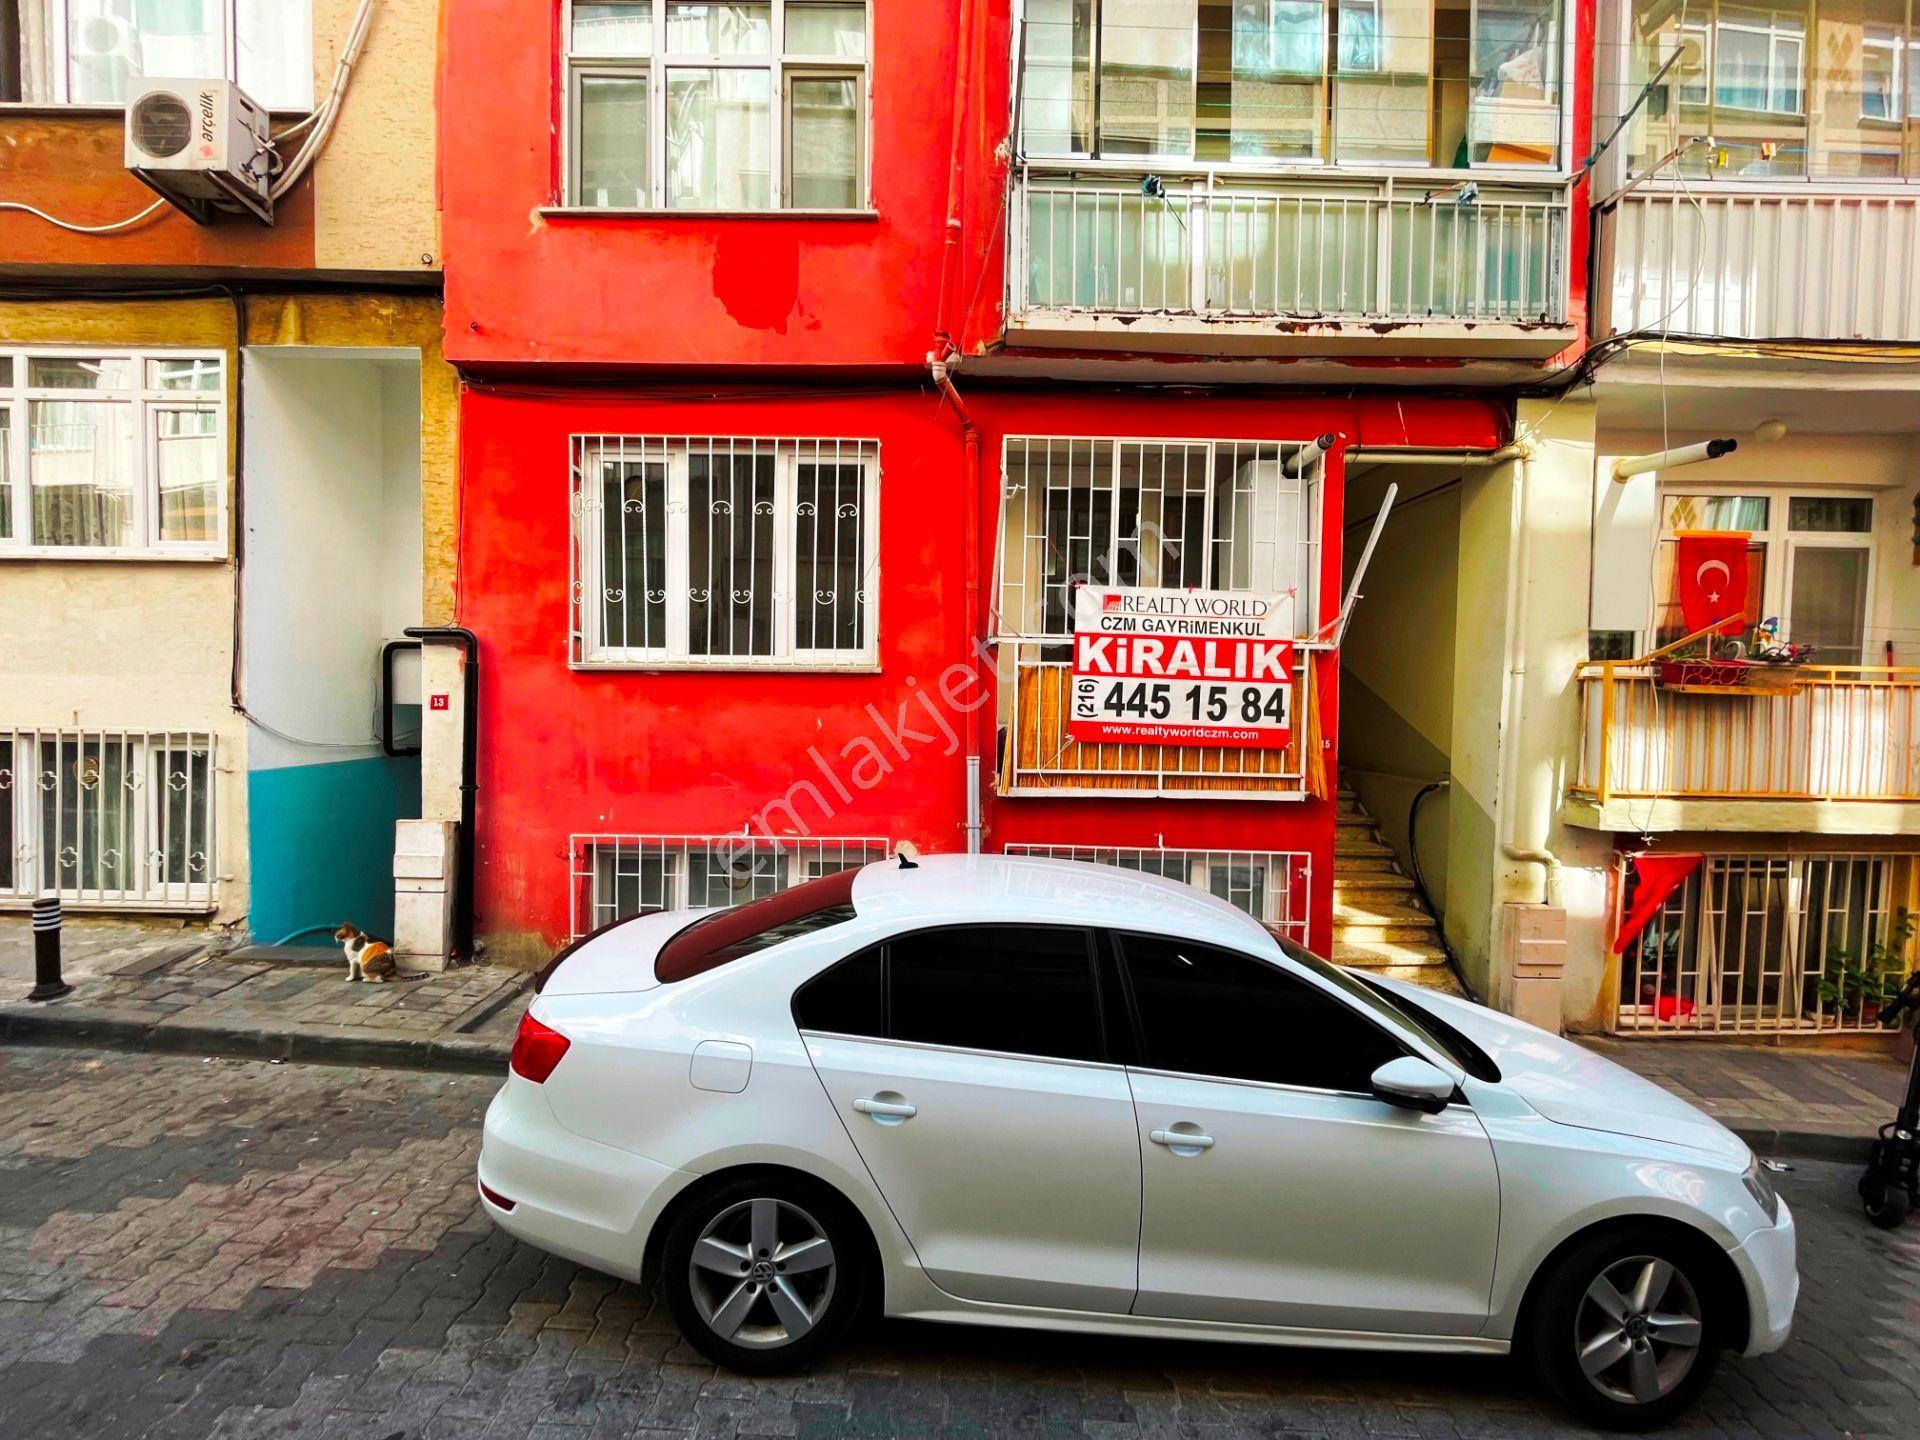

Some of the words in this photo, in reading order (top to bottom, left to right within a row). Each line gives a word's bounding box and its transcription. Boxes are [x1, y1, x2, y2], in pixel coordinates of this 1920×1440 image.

[200, 91, 216, 142] arçelik
[1123, 595, 1190, 614] REALTY
[1195, 598, 1268, 616] WORLD
[1101, 617, 1136, 631] CZM
[433, 697, 444, 707] 13
[1078, 678, 1099, 718] (216)
[1104, 682, 1171, 720] 445
[1186, 685, 1227, 721] 15
[1241, 686, 1285, 723] 84
[1102, 724, 1259, 740] www.realtyworldczm.com
